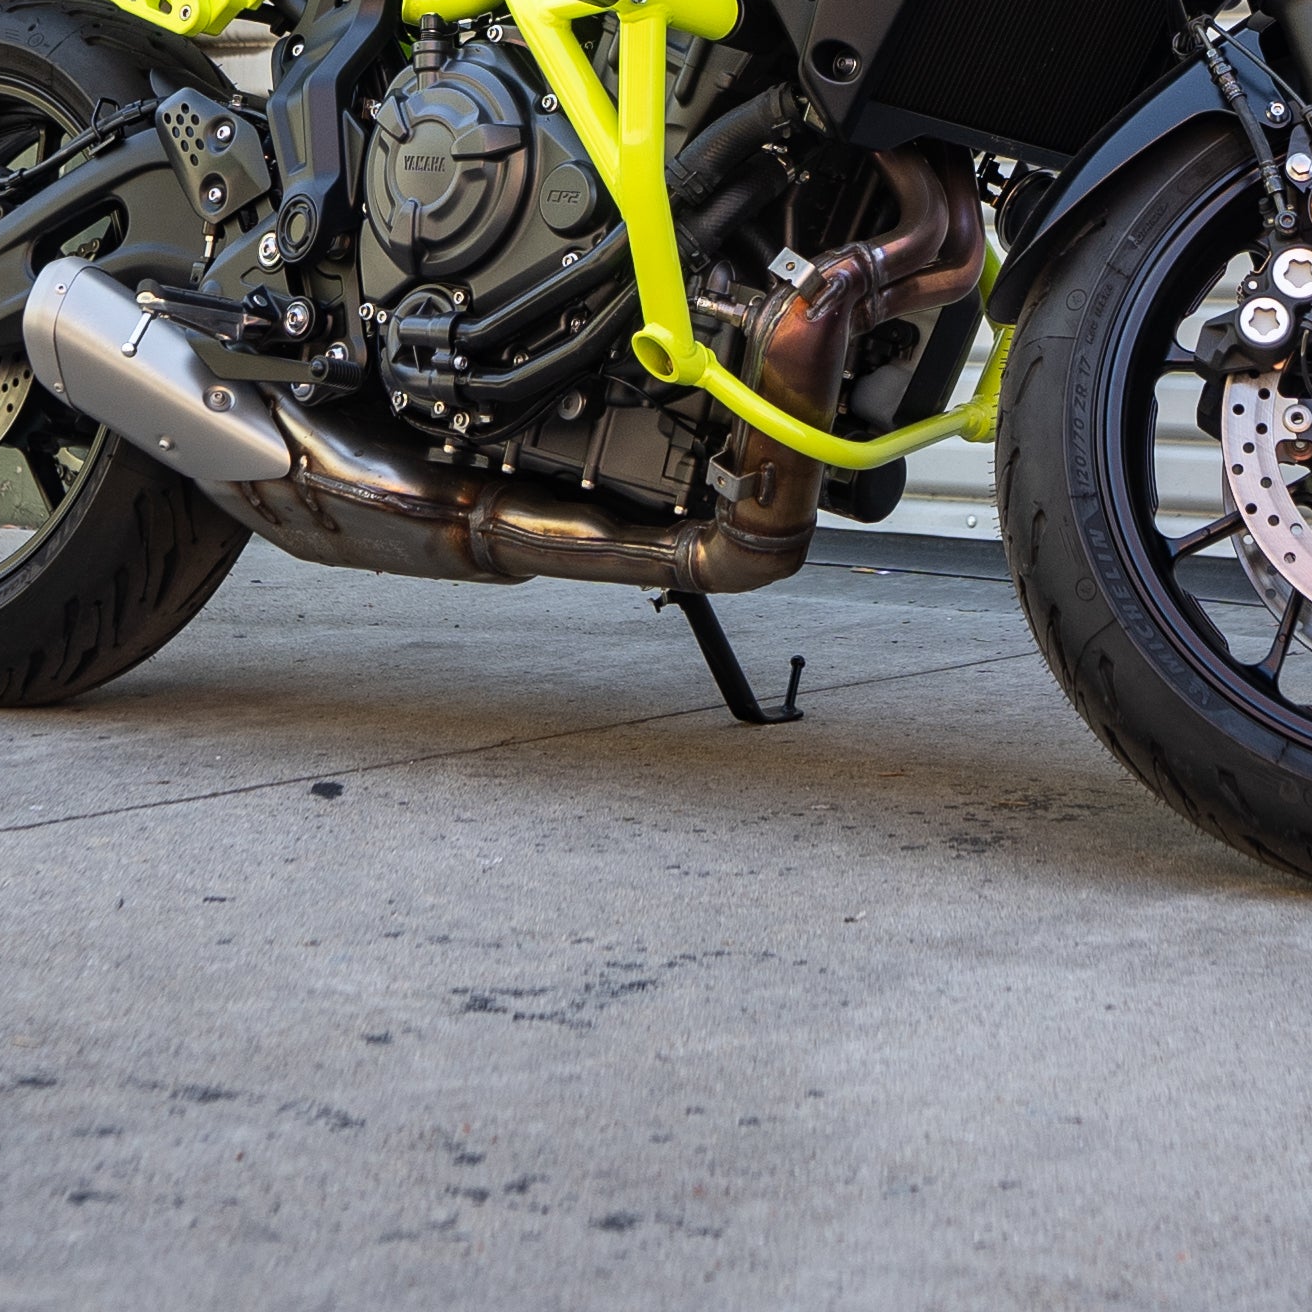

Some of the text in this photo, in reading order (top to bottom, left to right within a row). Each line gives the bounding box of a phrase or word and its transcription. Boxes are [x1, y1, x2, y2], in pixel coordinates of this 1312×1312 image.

[404, 155, 446, 172] YAMAHA
[547, 189, 581, 204] CP2
[1071, 357, 1092, 489] 120/70 ZR 17
[1088, 528, 1186, 674] MICHELIN
